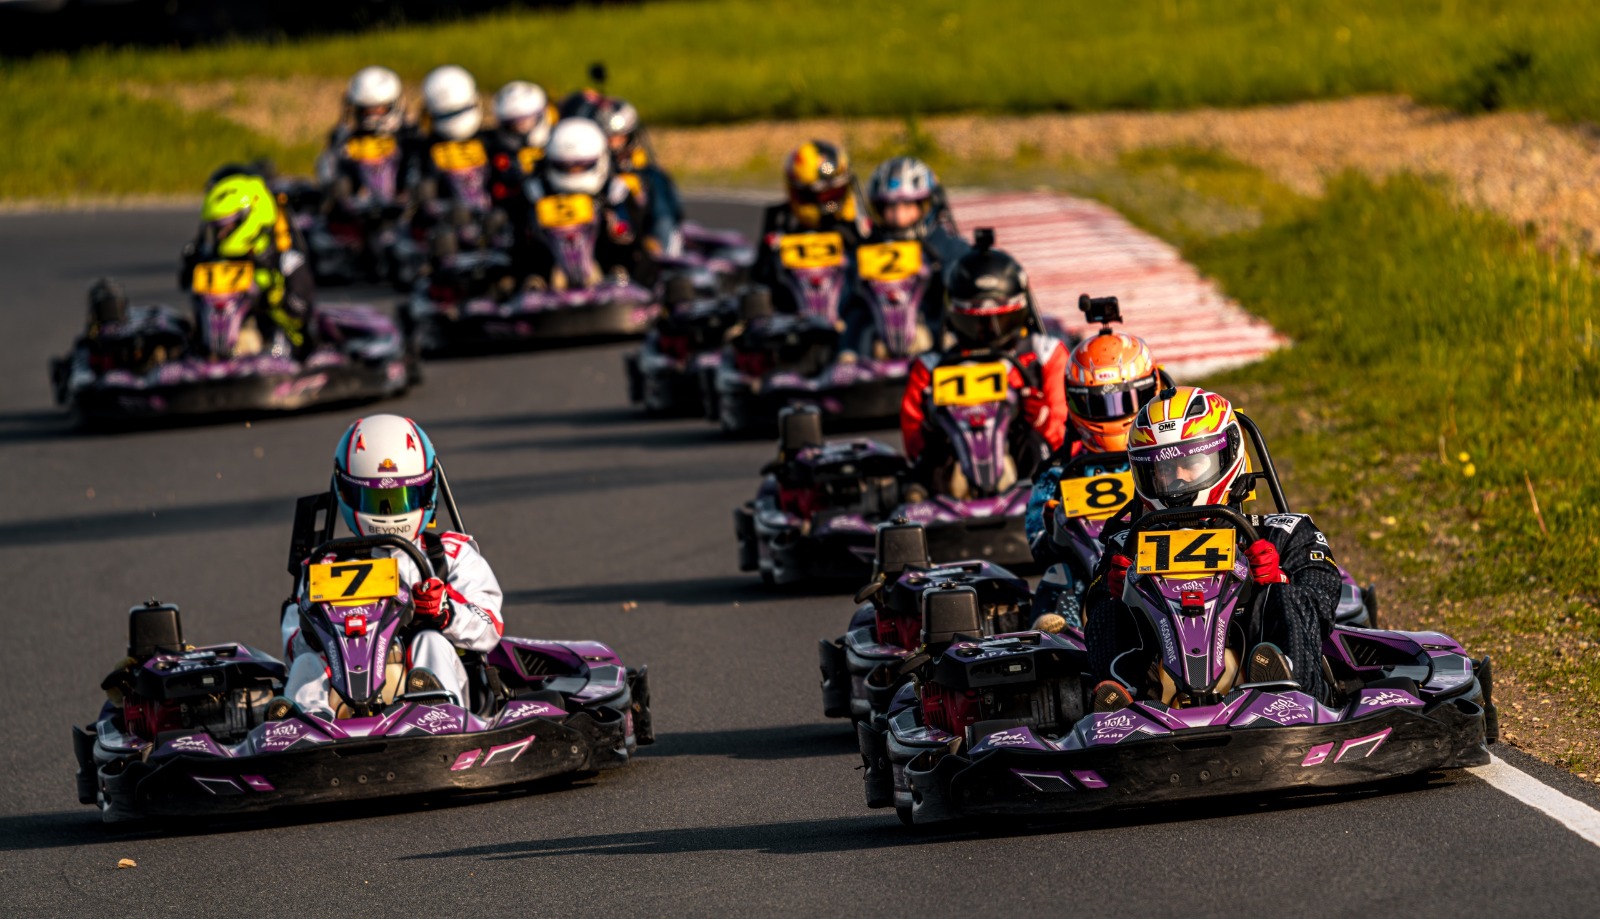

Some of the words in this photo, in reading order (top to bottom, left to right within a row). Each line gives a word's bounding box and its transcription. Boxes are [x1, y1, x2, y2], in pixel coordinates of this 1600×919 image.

[879, 248, 902, 274] 2
[202, 270, 244, 290] 17
[940, 373, 1004, 397] 11
[1158, 422, 1176, 432] OMP
[1188, 436, 1226, 455] #IGORADRIVE
[1085, 477, 1128, 509] 8
[368, 524, 411, 534] BEYOND
[1270, 517, 1295, 525] OMP
[1145, 533, 1228, 571] 14
[330, 563, 374, 597] 7
[1159, 617, 1177, 665] #IGORADRIVE
[1215, 616, 1226, 667] #IGORADRIVE
[1255, 655, 1270, 664] OMP
[1379, 697, 1411, 706] SPORT
[1092, 732, 1124, 741] ДРАЙВ
